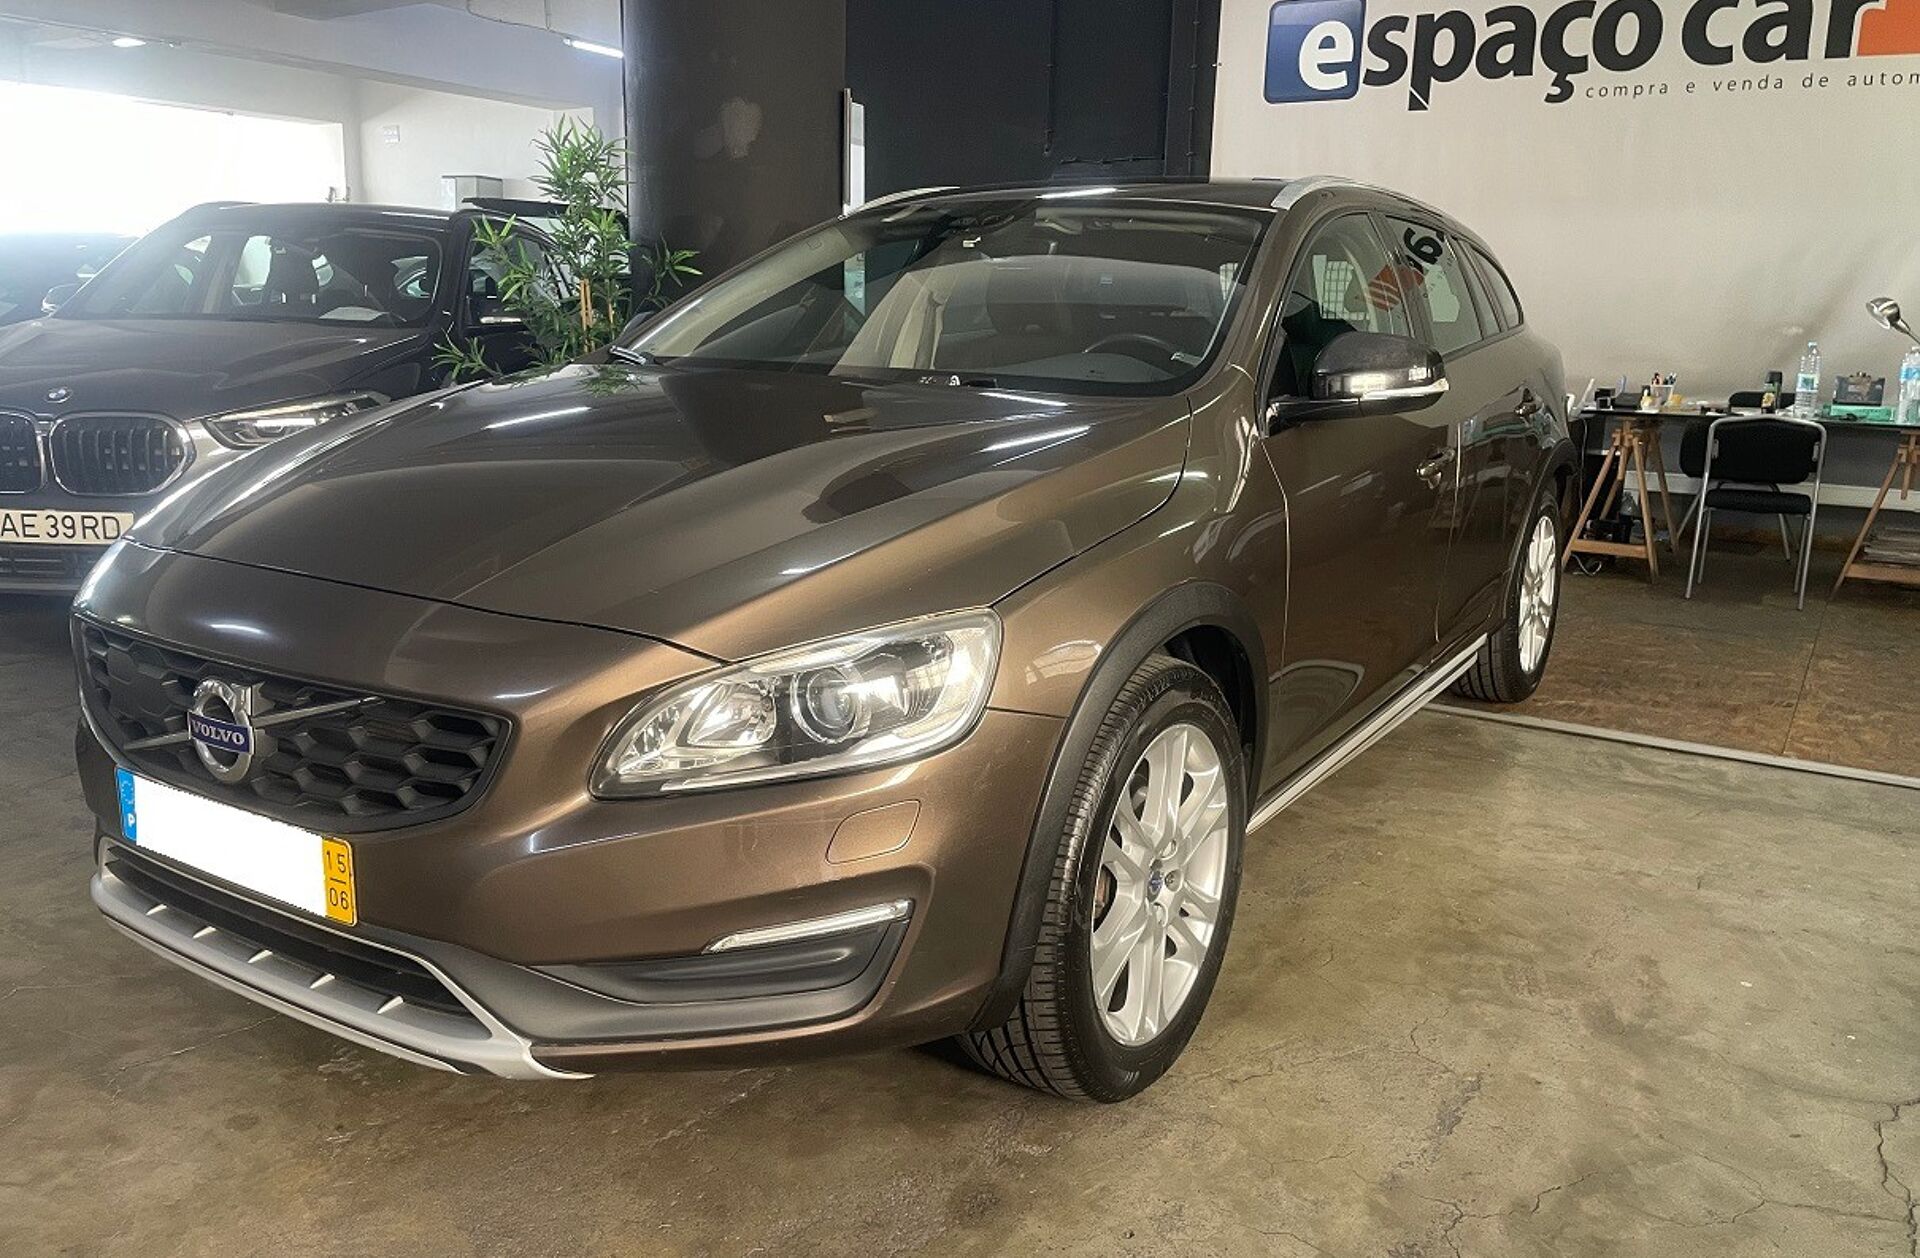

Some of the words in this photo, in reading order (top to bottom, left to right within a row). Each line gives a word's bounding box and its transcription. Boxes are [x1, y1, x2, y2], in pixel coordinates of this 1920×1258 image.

[1300, 0, 1664, 111] espaço
[1682, 0, 1879, 66] car
[1585, 83, 1669, 98] compra
[1686, 81, 1695, 93] e
[1713, 74, 1783, 91] venda
[1802, 73, 1829, 88] de
[191, 719, 245, 745] VOLVO
[326, 850, 346, 873] 15
[329, 887, 349, 909] 06
